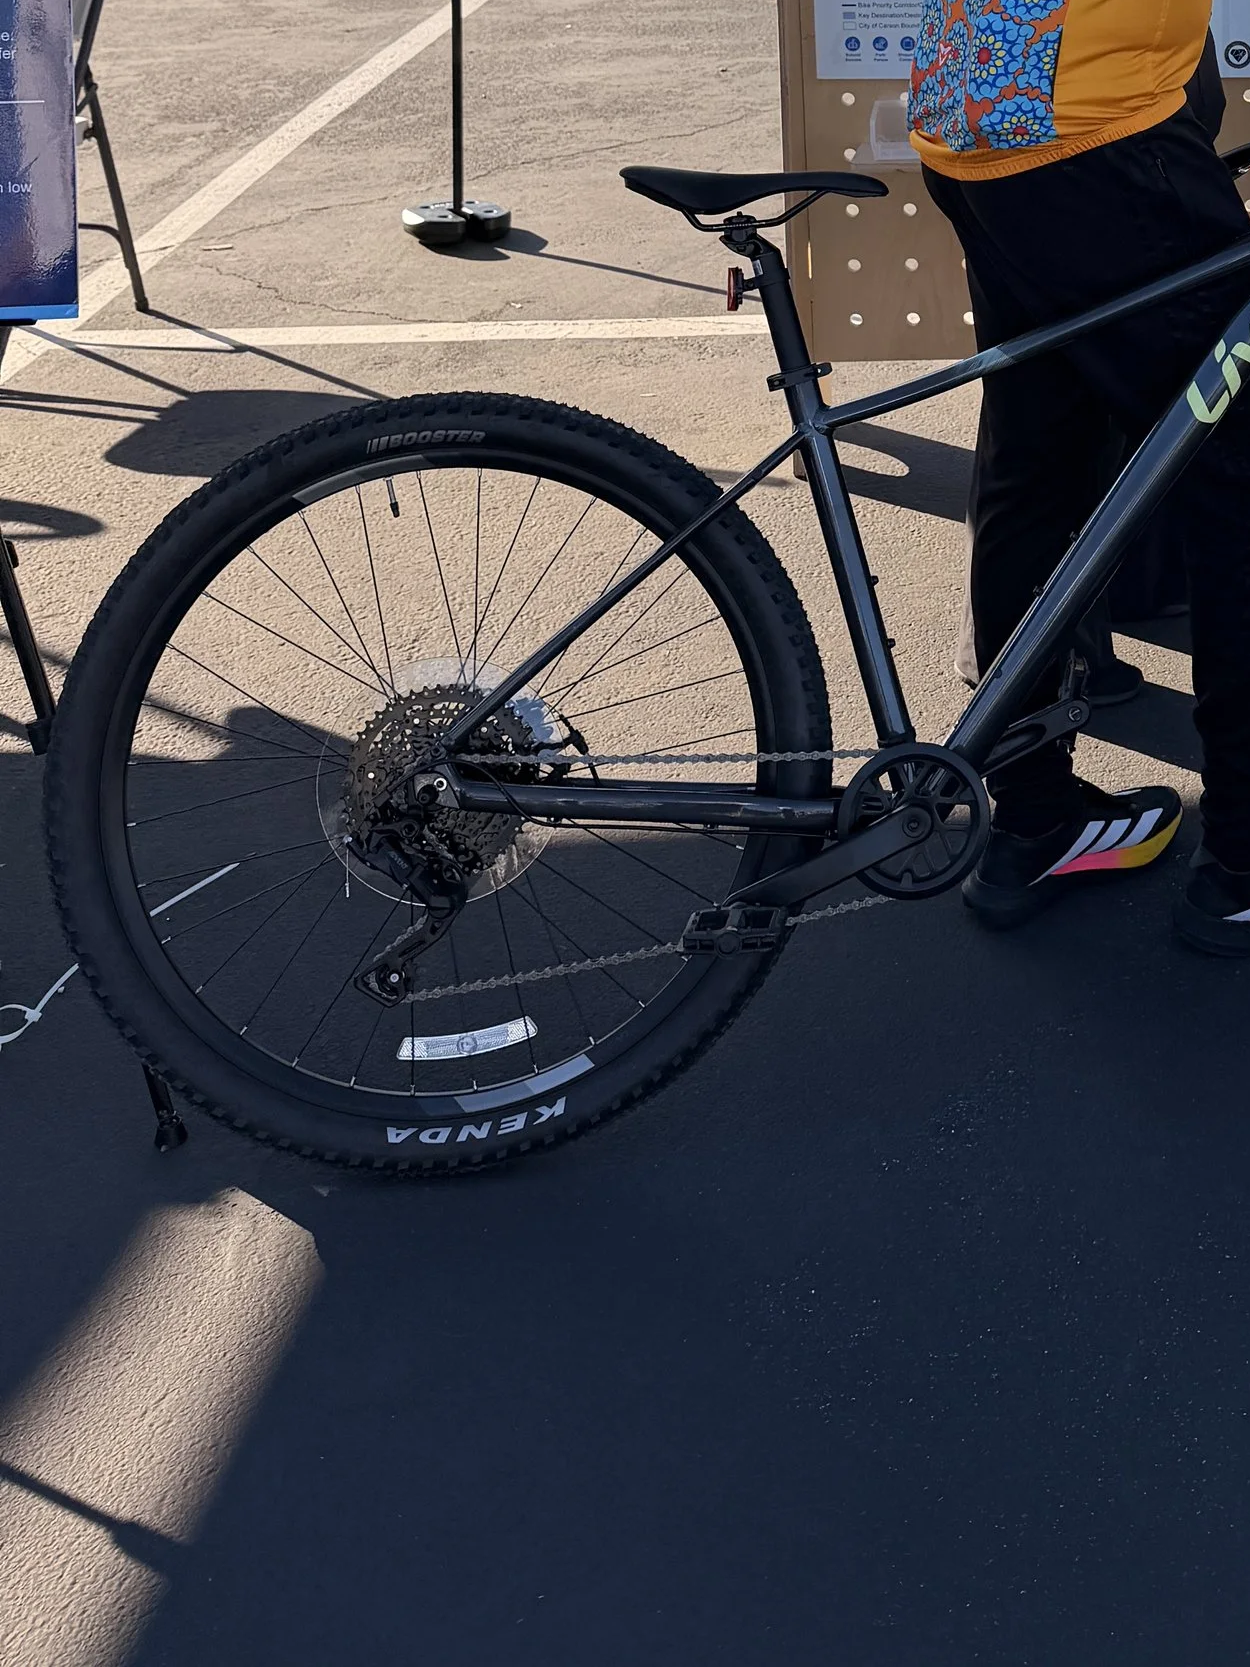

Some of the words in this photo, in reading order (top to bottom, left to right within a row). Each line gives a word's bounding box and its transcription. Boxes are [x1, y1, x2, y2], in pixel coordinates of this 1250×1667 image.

[8, 181, 32, 193] low
[388, 429, 487, 449] BOOSTER
[386, 1096, 567, 1144] KENDA
